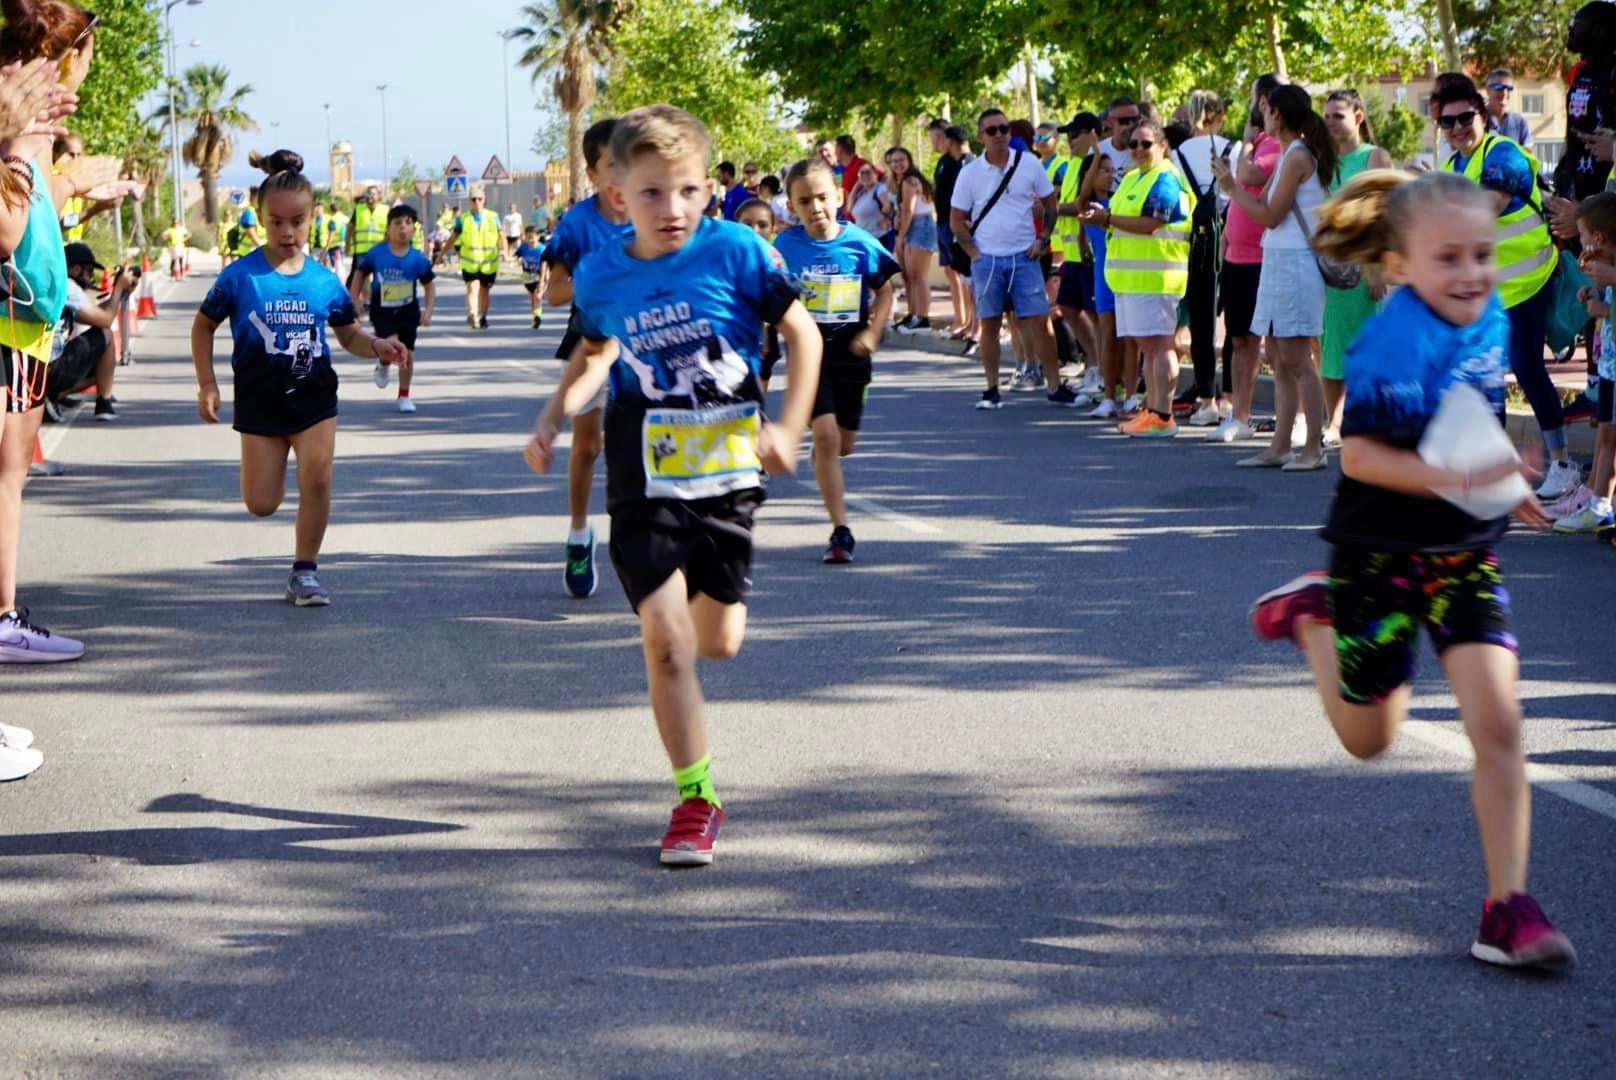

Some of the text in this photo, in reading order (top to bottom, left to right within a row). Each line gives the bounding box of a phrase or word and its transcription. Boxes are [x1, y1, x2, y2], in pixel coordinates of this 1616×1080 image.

[276, 300, 306, 312] ROAD
[638, 301, 692, 329] ROAD
[266, 313, 315, 325] RUNNING
[629, 318, 712, 353] RUNNING
